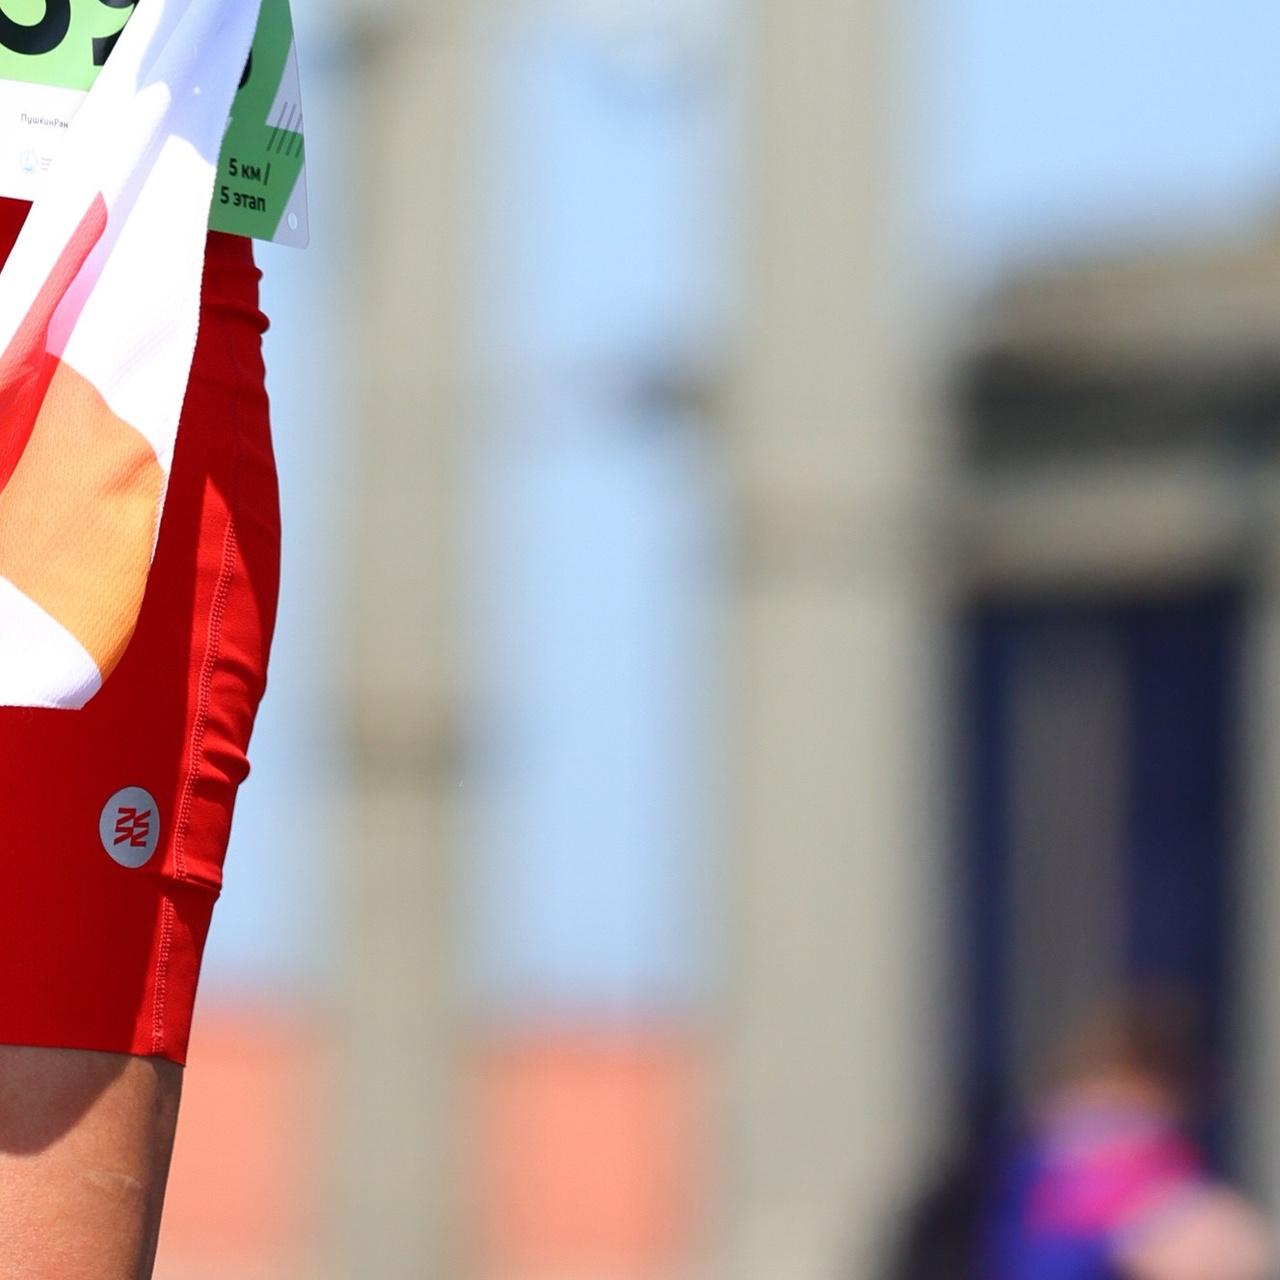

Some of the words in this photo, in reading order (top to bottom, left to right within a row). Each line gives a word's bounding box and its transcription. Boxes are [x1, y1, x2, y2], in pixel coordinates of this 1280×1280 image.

[228, 157, 238, 176] 5
[220, 185, 229, 204] 5
[233, 192, 266, 212] этап
